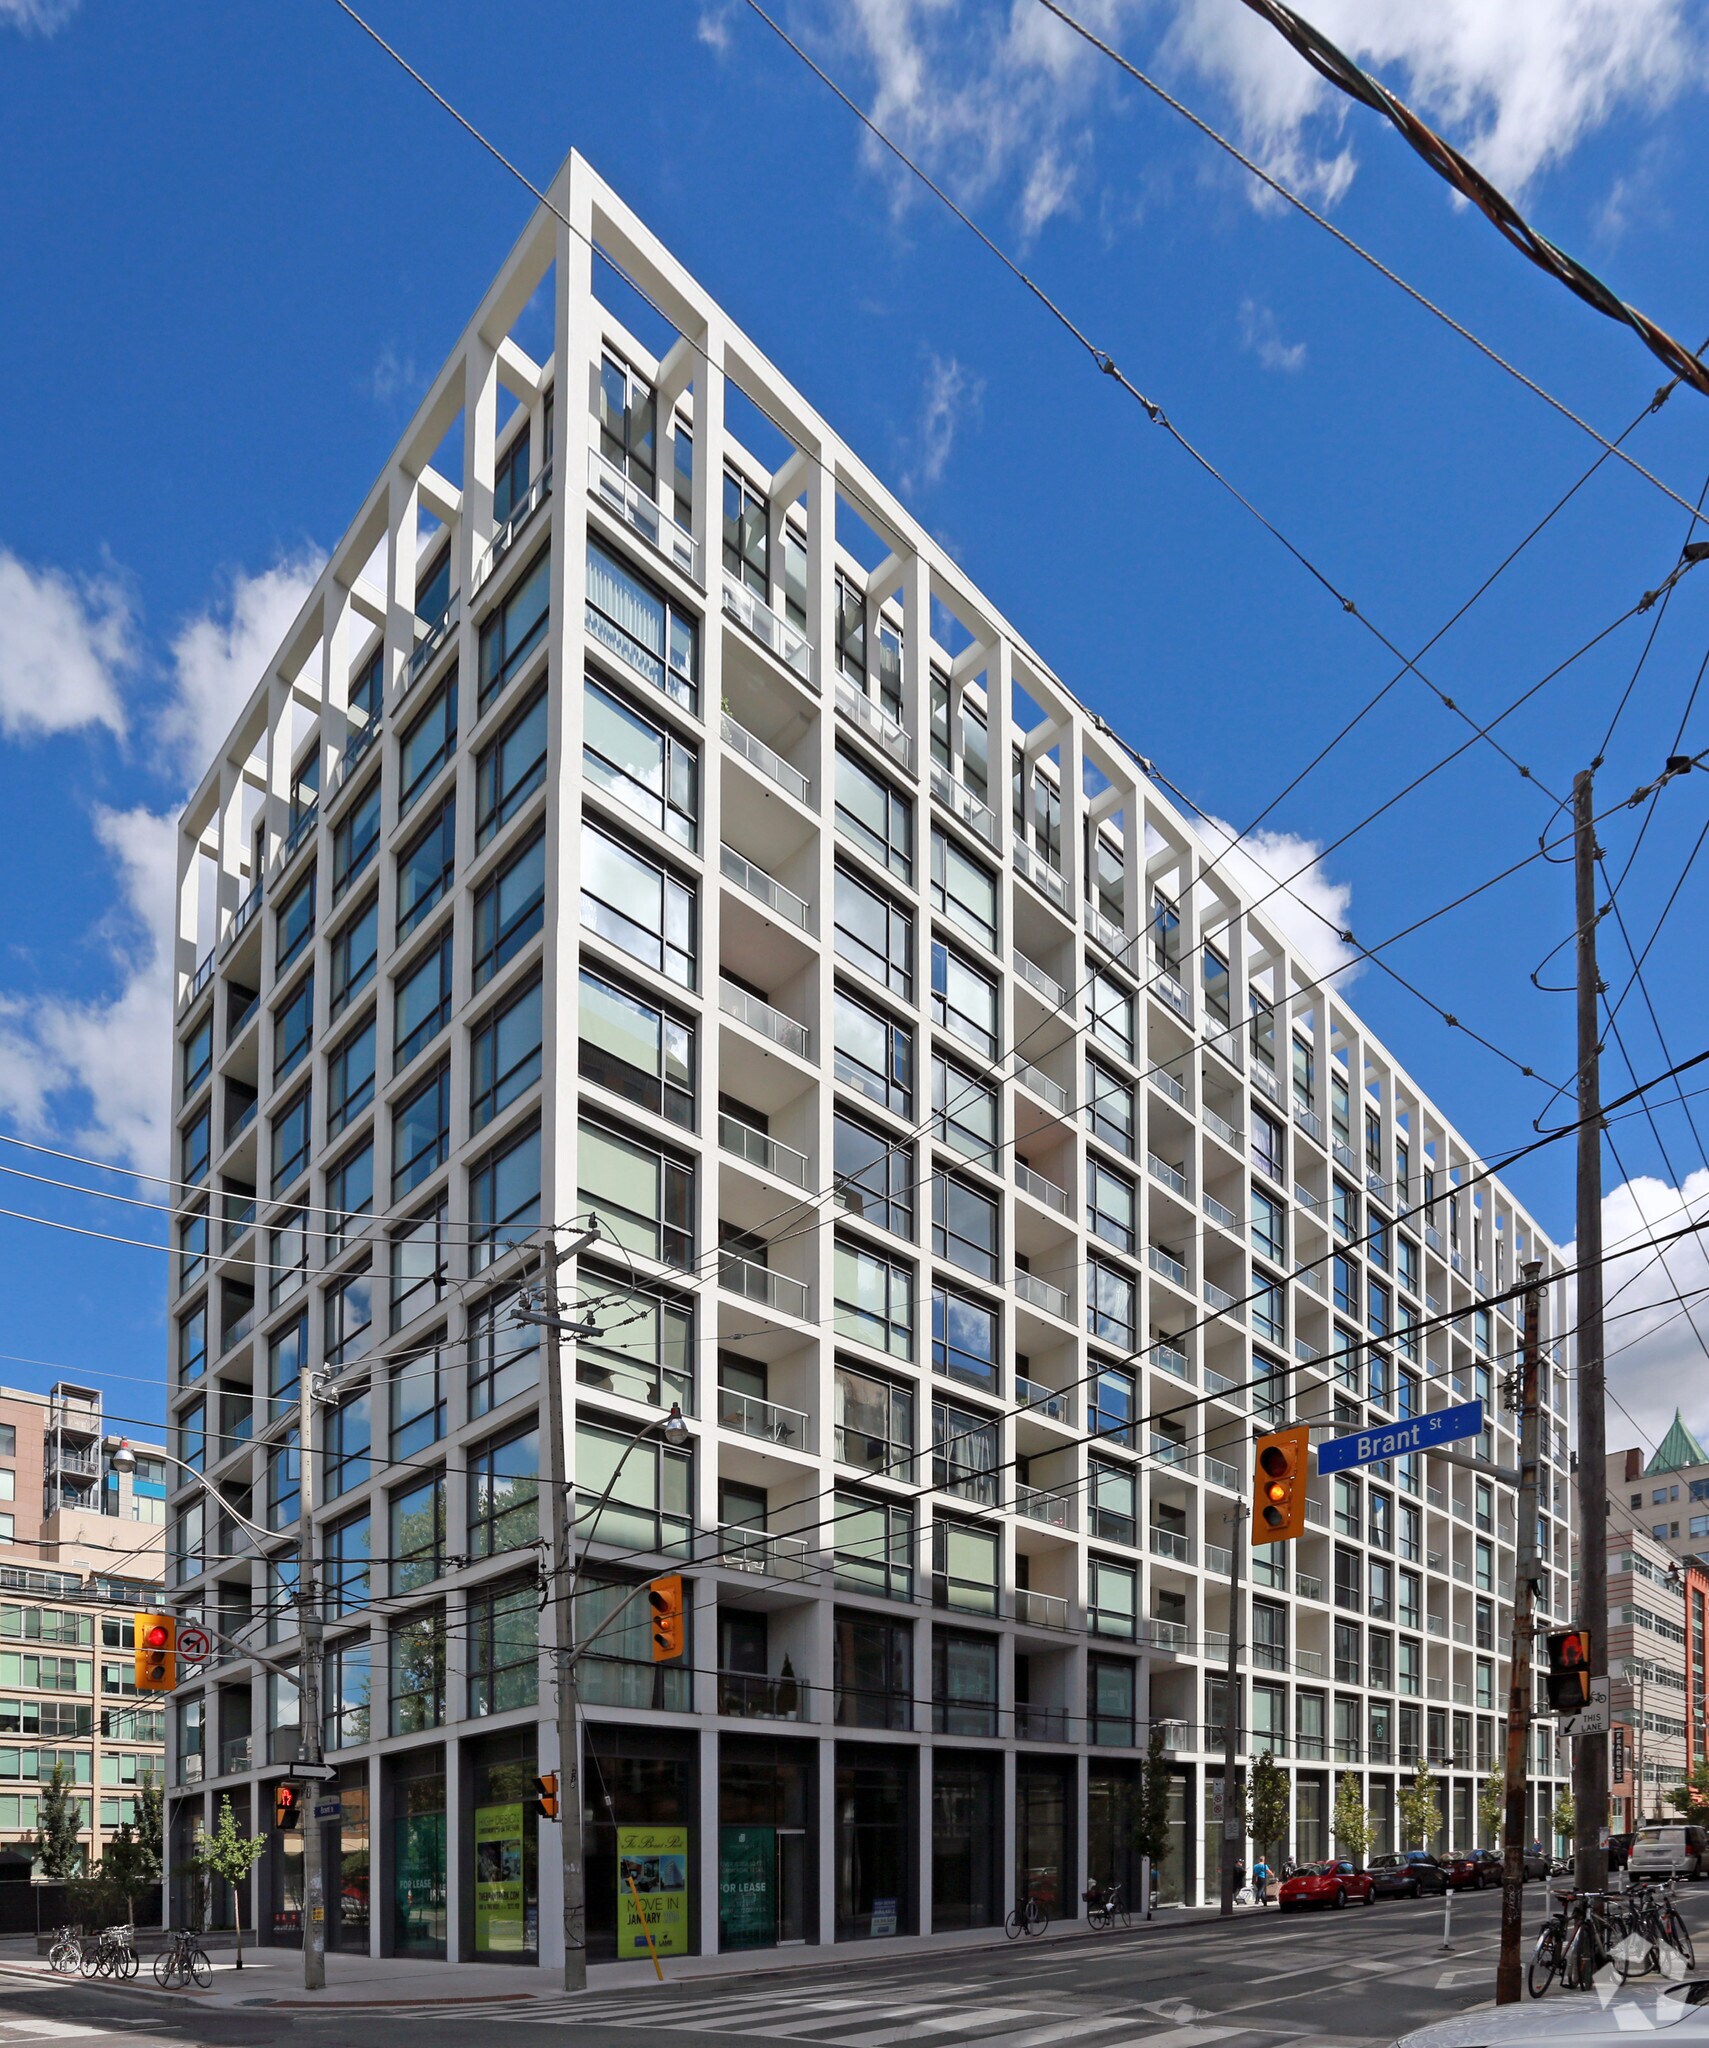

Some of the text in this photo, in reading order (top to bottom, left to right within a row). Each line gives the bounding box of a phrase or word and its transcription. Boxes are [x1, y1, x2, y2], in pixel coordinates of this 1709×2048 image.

[1357, 1417, 1442, 1460] Brant St
[1583, 1713, 1601, 1723] THIS
[1581, 1722, 1602, 1732] LANE
[1615, 1732, 1623, 1779] FEARLESS
[399, 1879, 432, 1890] FOR LEASE
[738, 1882, 766, 1893] LEASE
[627, 1896, 679, 1912] MOVE IN
